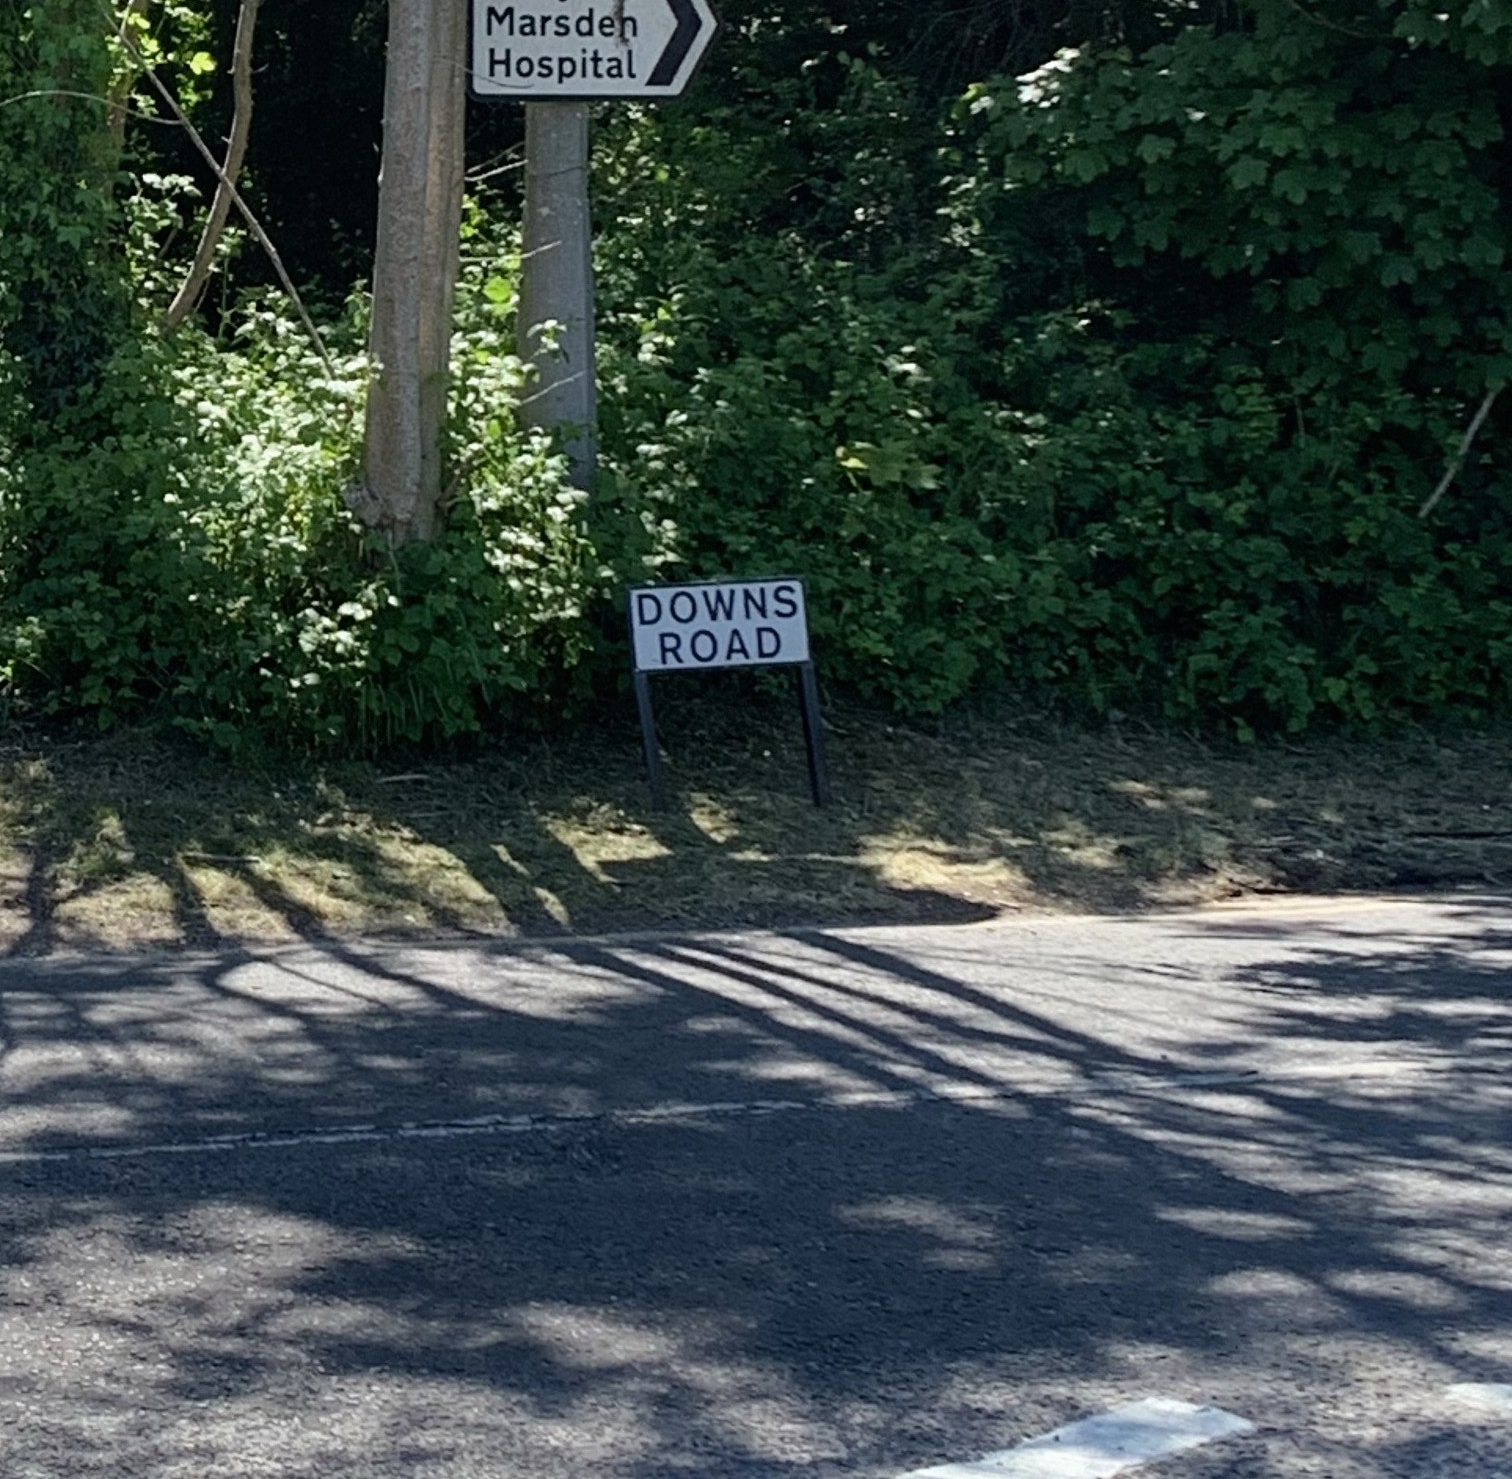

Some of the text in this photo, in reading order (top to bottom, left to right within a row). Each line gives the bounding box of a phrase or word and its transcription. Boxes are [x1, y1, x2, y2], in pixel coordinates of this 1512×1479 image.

[486, 6, 638, 38] Marsden
[488, 47, 637, 85] Hospital
[637, 585, 798, 626] DOWNS
[658, 626, 782, 665] ROAD
